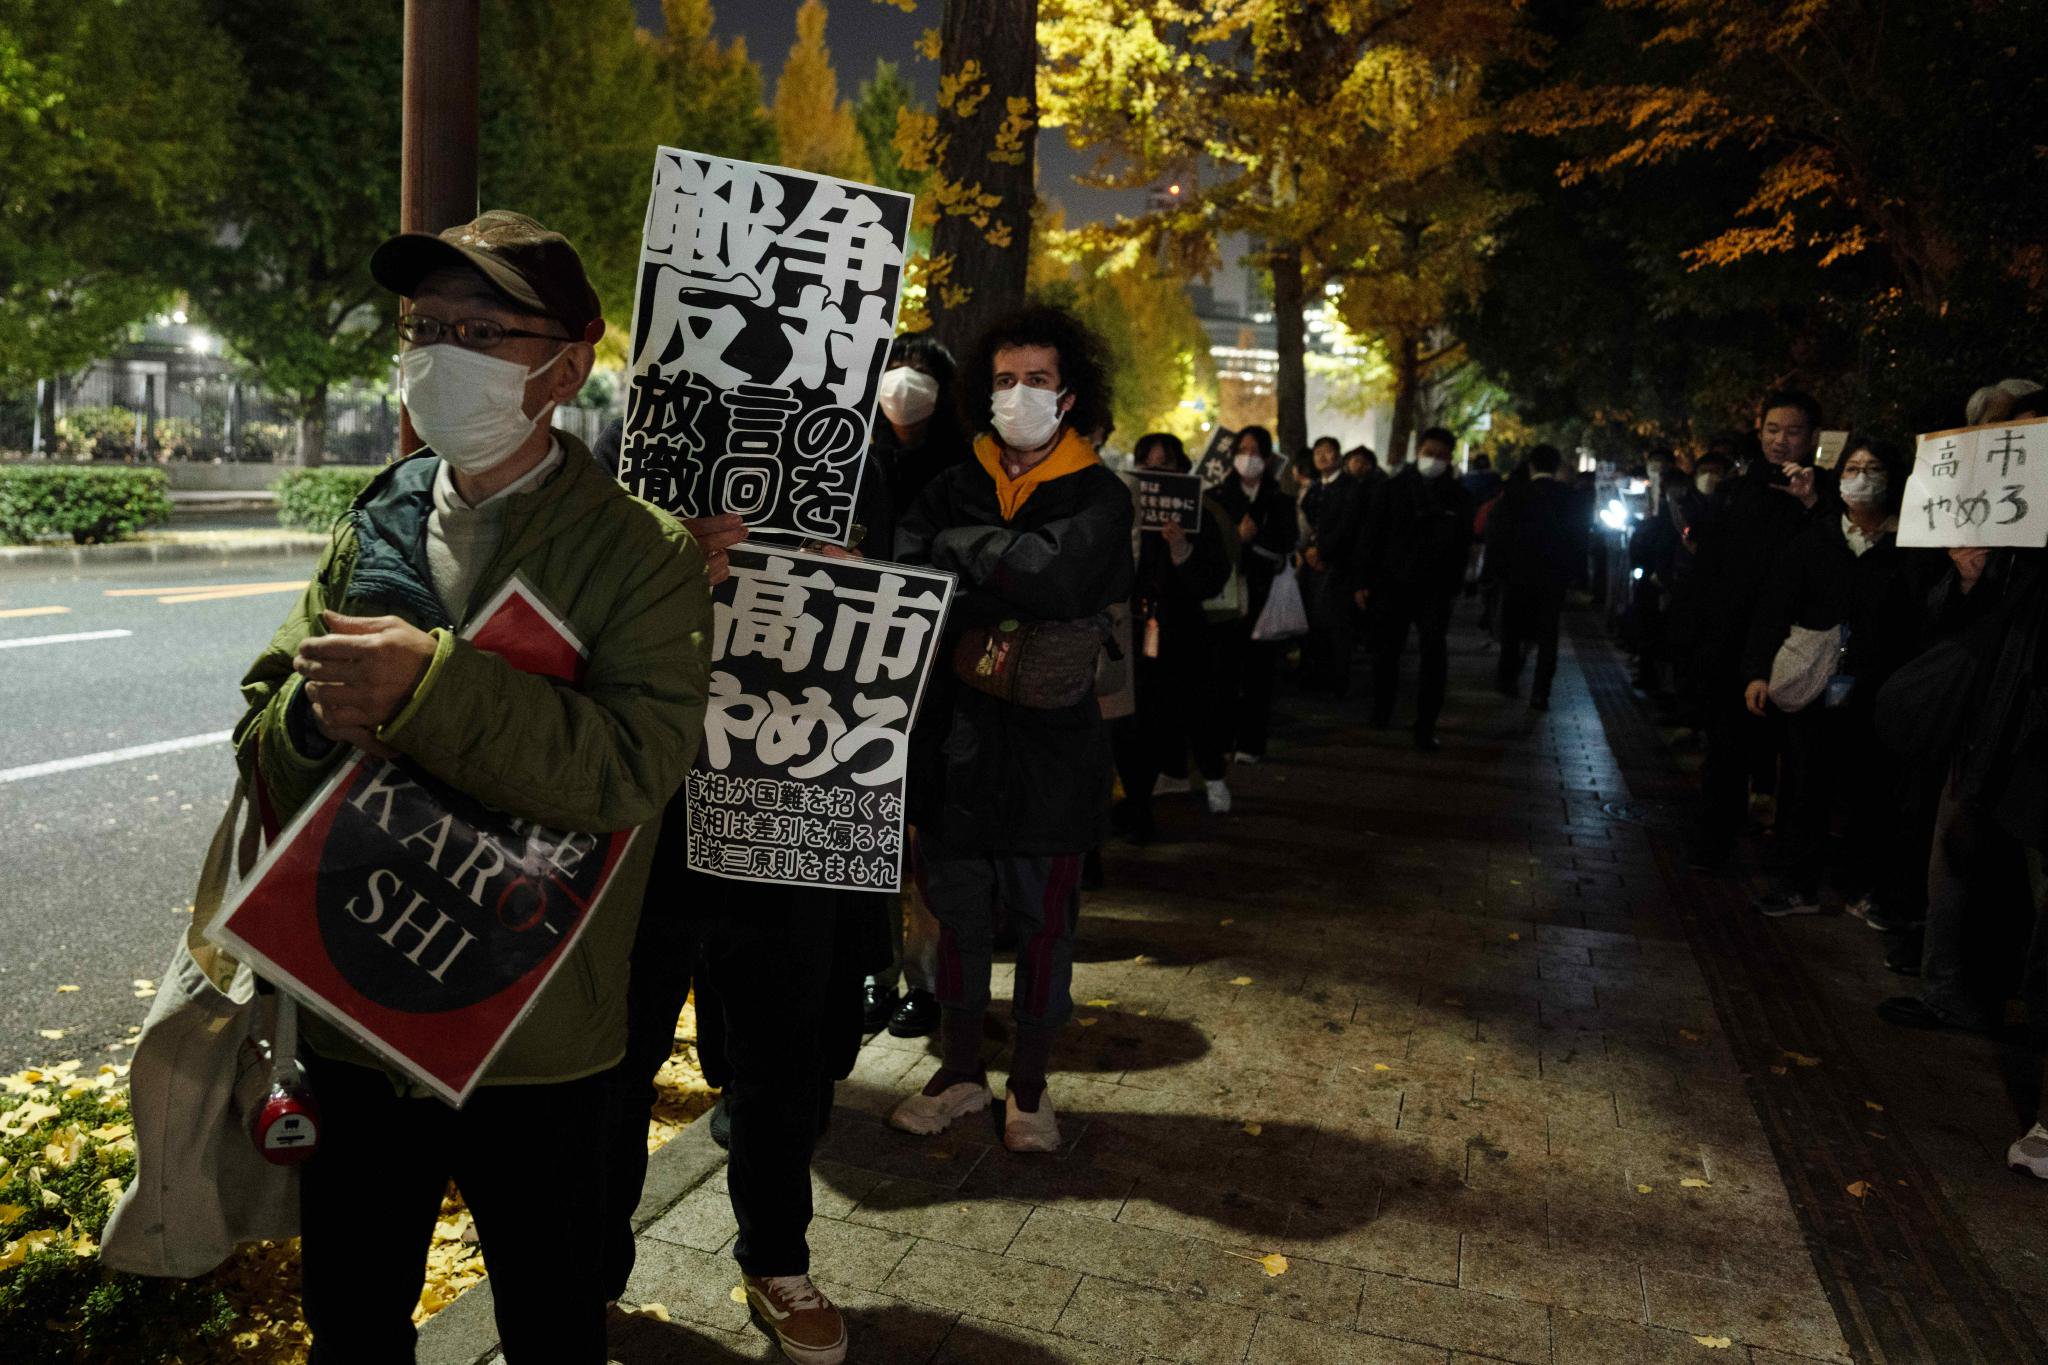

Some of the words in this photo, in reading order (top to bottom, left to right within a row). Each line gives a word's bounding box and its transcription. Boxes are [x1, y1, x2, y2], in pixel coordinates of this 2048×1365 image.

[646, 151, 902, 307] 戦争
[632, 263, 892, 409] 反対
[625, 363, 868, 467] 放言の
[1931, 429, 2026, 479] 高市
[620, 430, 853, 538] 撤回を
[1922, 484, 2029, 531] やめろ
[703, 671, 909, 787] やめろ
[686, 768, 901, 822] 首相が国難を招くな
[687, 800, 900, 855] 首相は差別を煽るな
[688, 832, 899, 887] 非核三原則をまもれ
[344, 868, 480, 985] SHI
